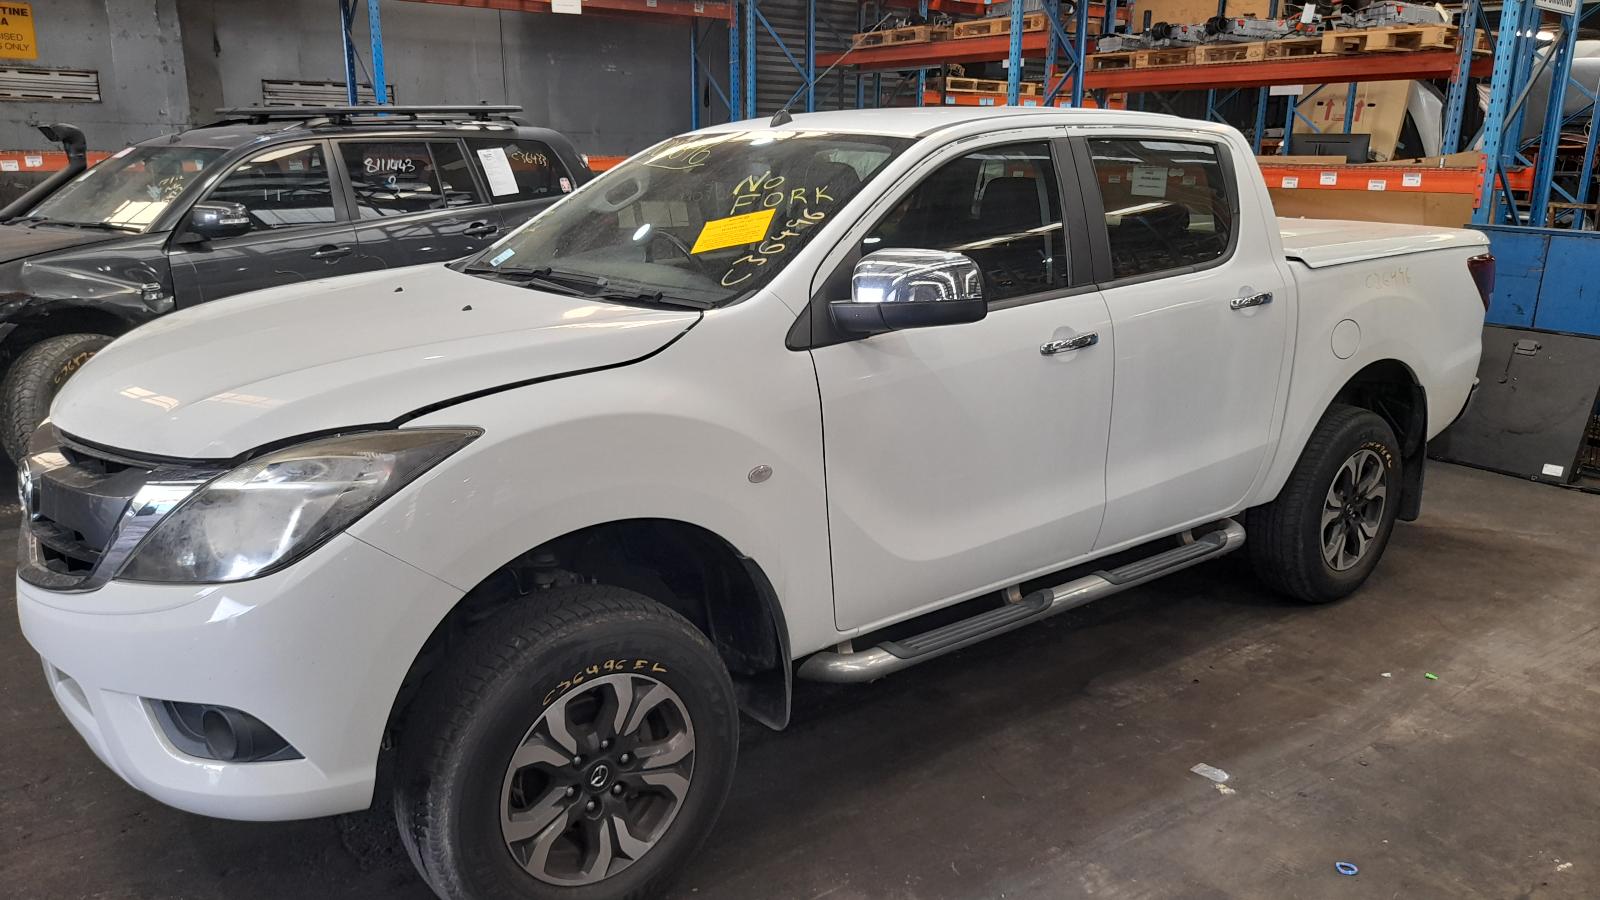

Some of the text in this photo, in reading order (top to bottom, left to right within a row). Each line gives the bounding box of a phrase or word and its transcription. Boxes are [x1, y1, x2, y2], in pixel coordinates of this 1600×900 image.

[5, 42, 30, 52] ONLY
[730, 185, 834, 215] FORK
[721, 208, 825, 286] C36496
